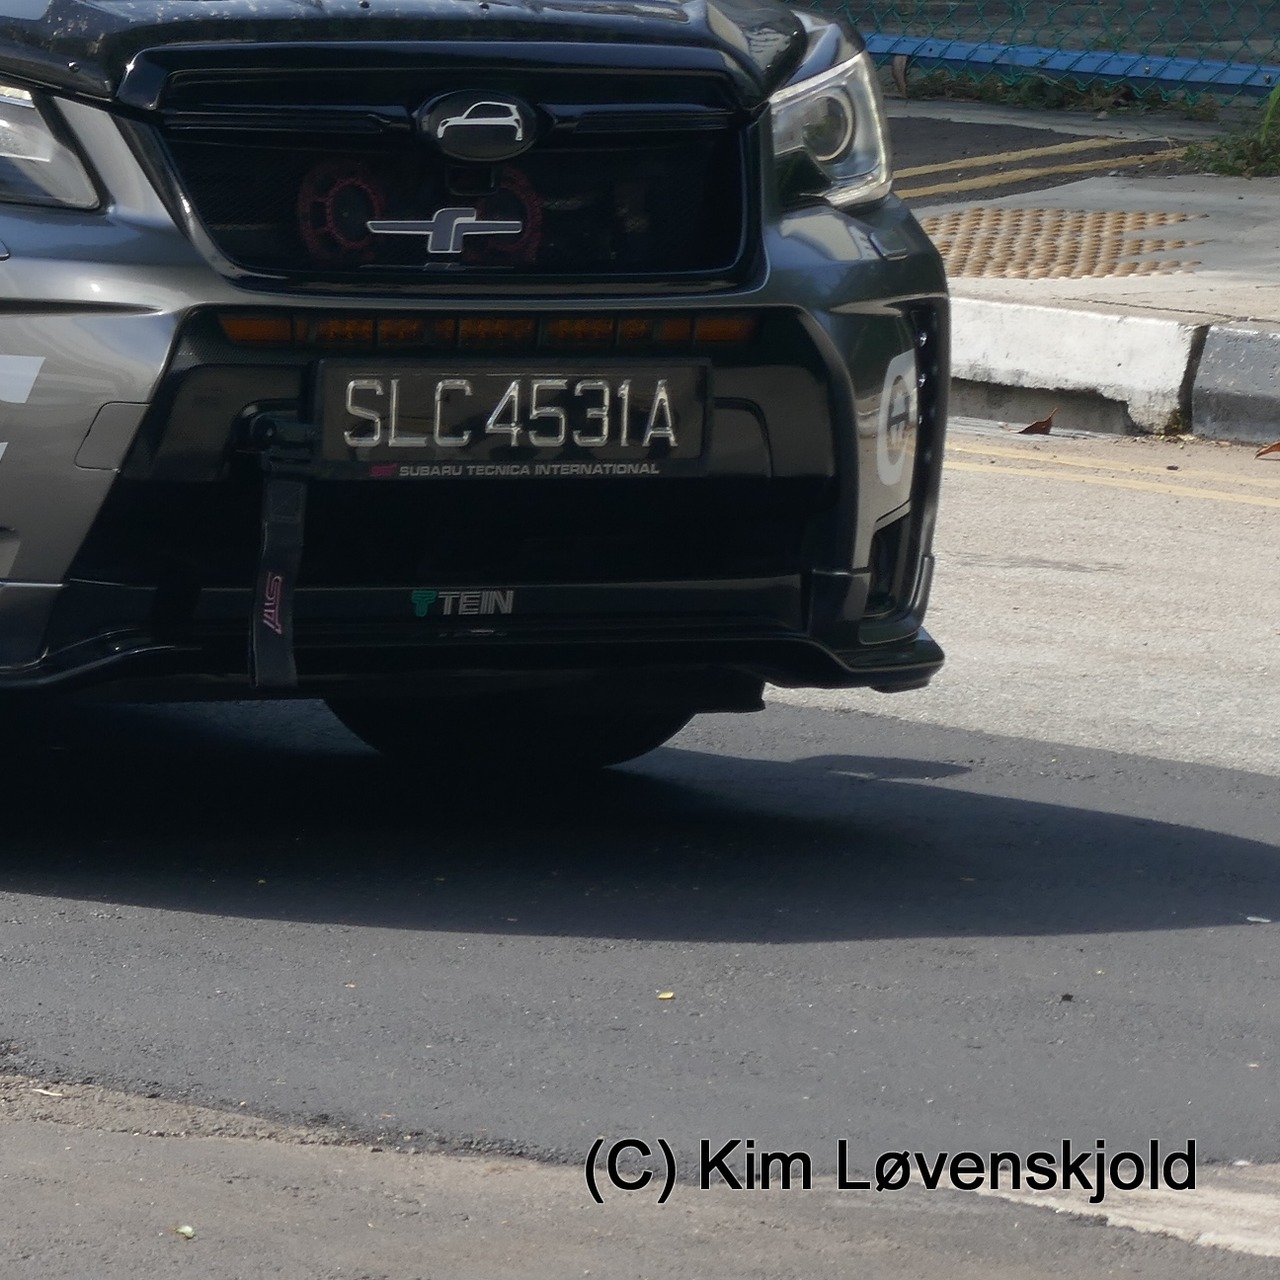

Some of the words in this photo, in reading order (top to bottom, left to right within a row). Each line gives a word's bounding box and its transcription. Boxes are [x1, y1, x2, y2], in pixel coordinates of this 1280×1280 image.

[343, 378, 473, 448] SLC
[484, 377, 679, 448] 4531A
[399, 465, 463, 477] SUBARU
[467, 463, 531, 476] TECNICA
[534, 462, 661, 476] INTERNATIONAL
[438, 590, 515, 615] TEIN
